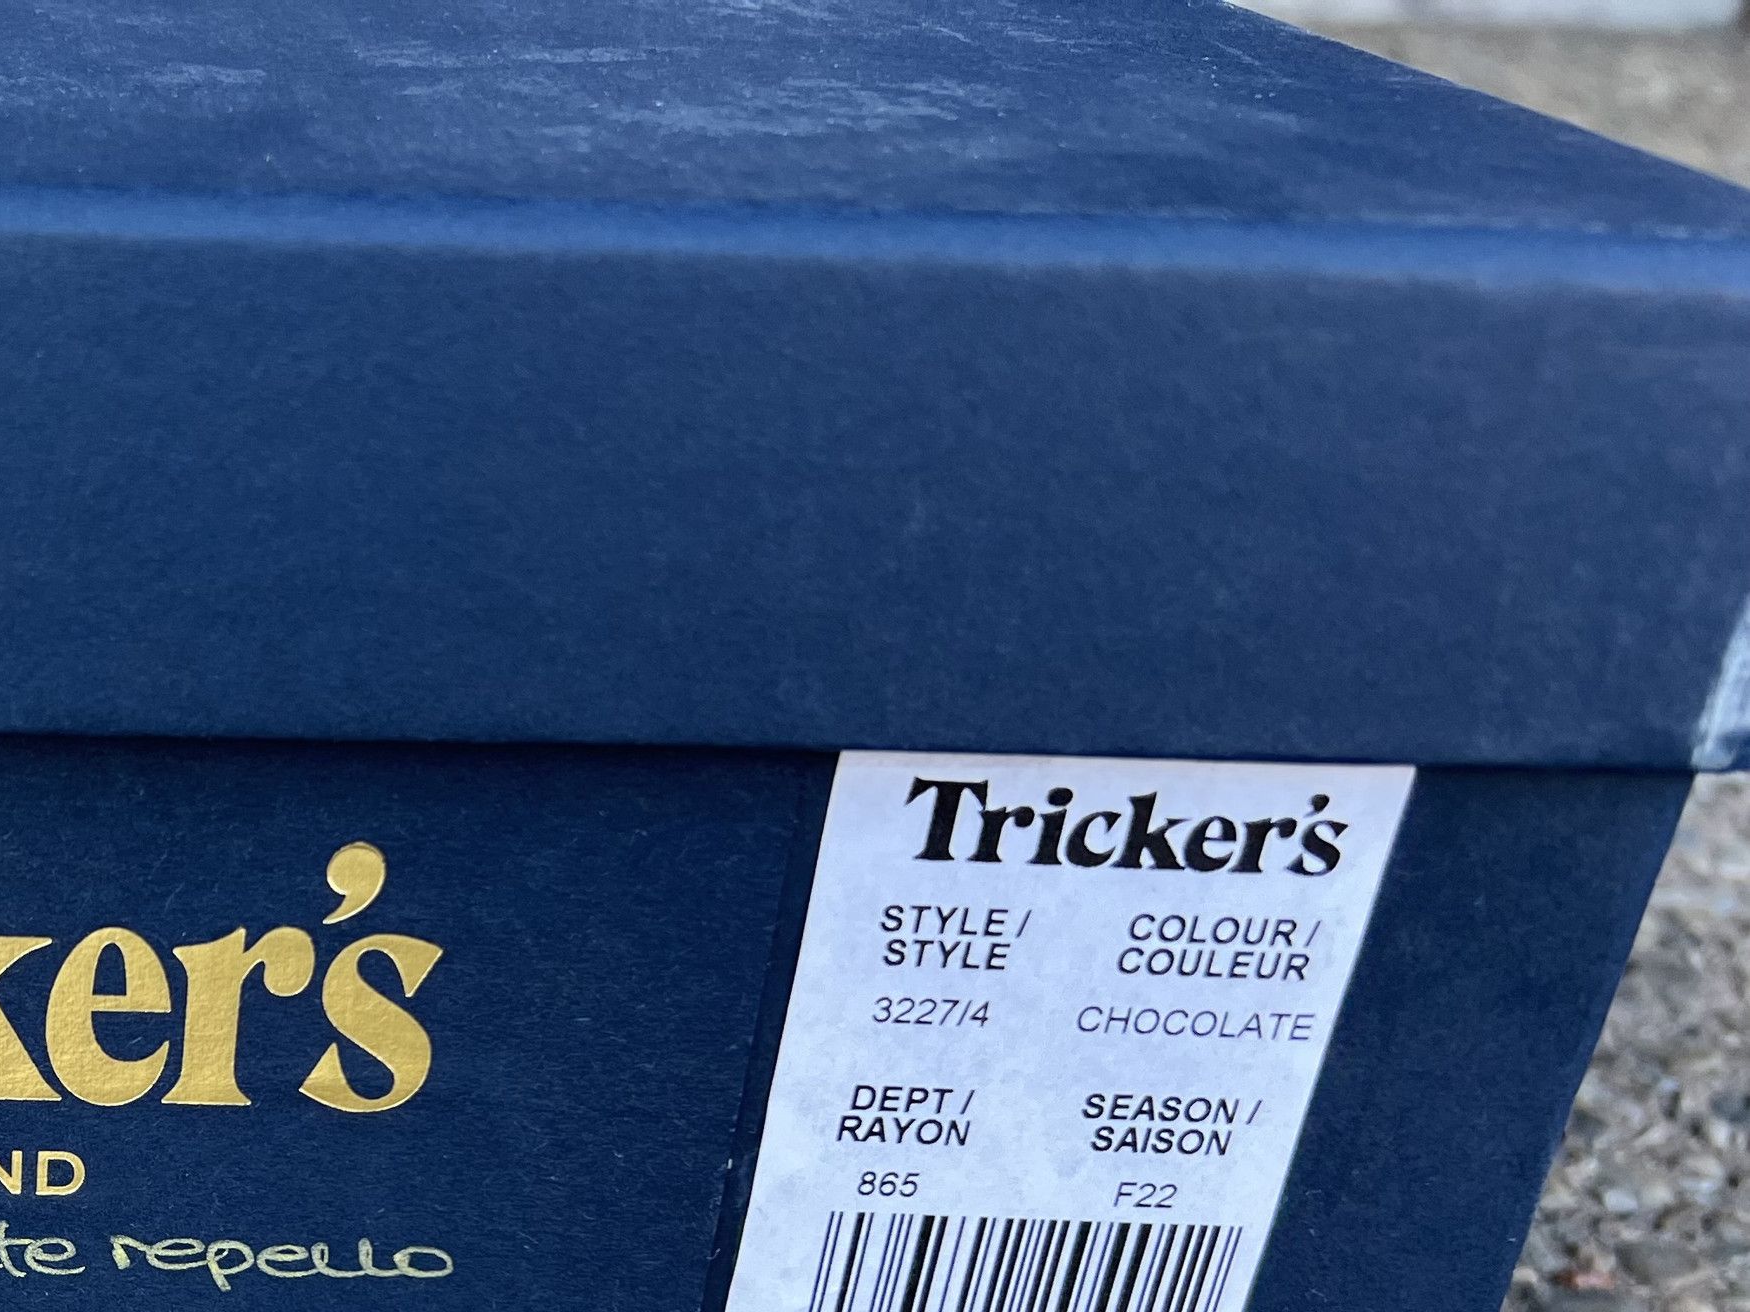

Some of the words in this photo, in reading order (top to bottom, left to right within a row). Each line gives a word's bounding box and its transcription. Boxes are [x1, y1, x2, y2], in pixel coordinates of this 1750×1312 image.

[905, 777, 1349, 877] Tricker's
[883, 938, 1011, 971] STYLE
[1118, 947, 1310, 981] COULEUR
[873, 997, 989, 1027] 3227/4
[1078, 1006, 1315, 1040] CHOCOLATE
[837, 1115, 971, 1146] RAYON
[1090, 1125, 1232, 1156] SAISON
[857, 1171, 920, 1198] 865
[1114, 1182, 1178, 1209] F22
[110, 1234, 454, 1291] repello
